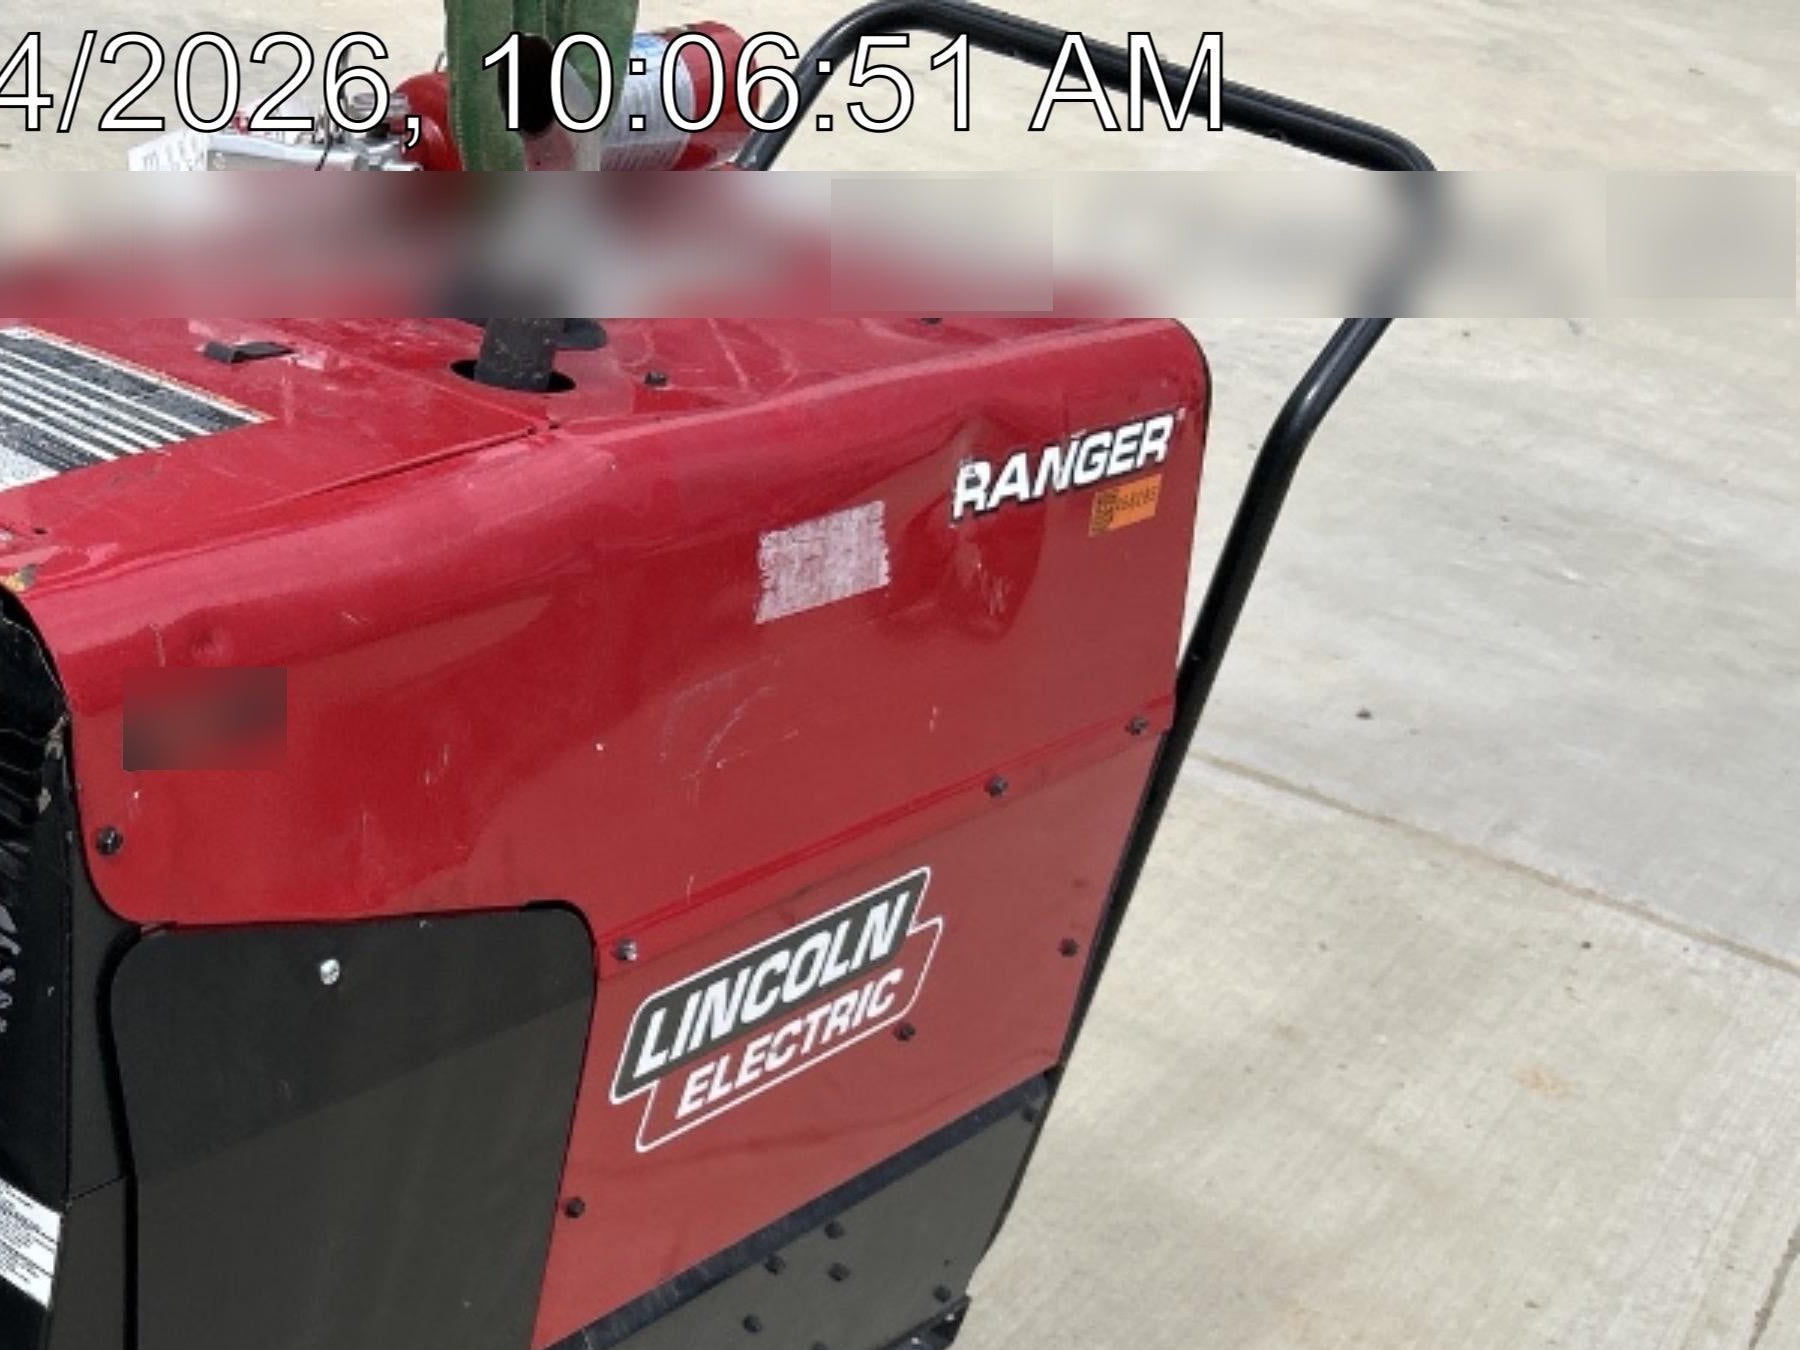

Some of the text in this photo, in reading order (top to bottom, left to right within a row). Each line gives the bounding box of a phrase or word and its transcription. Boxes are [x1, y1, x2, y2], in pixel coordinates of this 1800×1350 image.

[952, 413, 1175, 519] RANGER
[632, 891, 911, 1079] LINCOLN
[675, 967, 903, 1120] ELECTRIC
